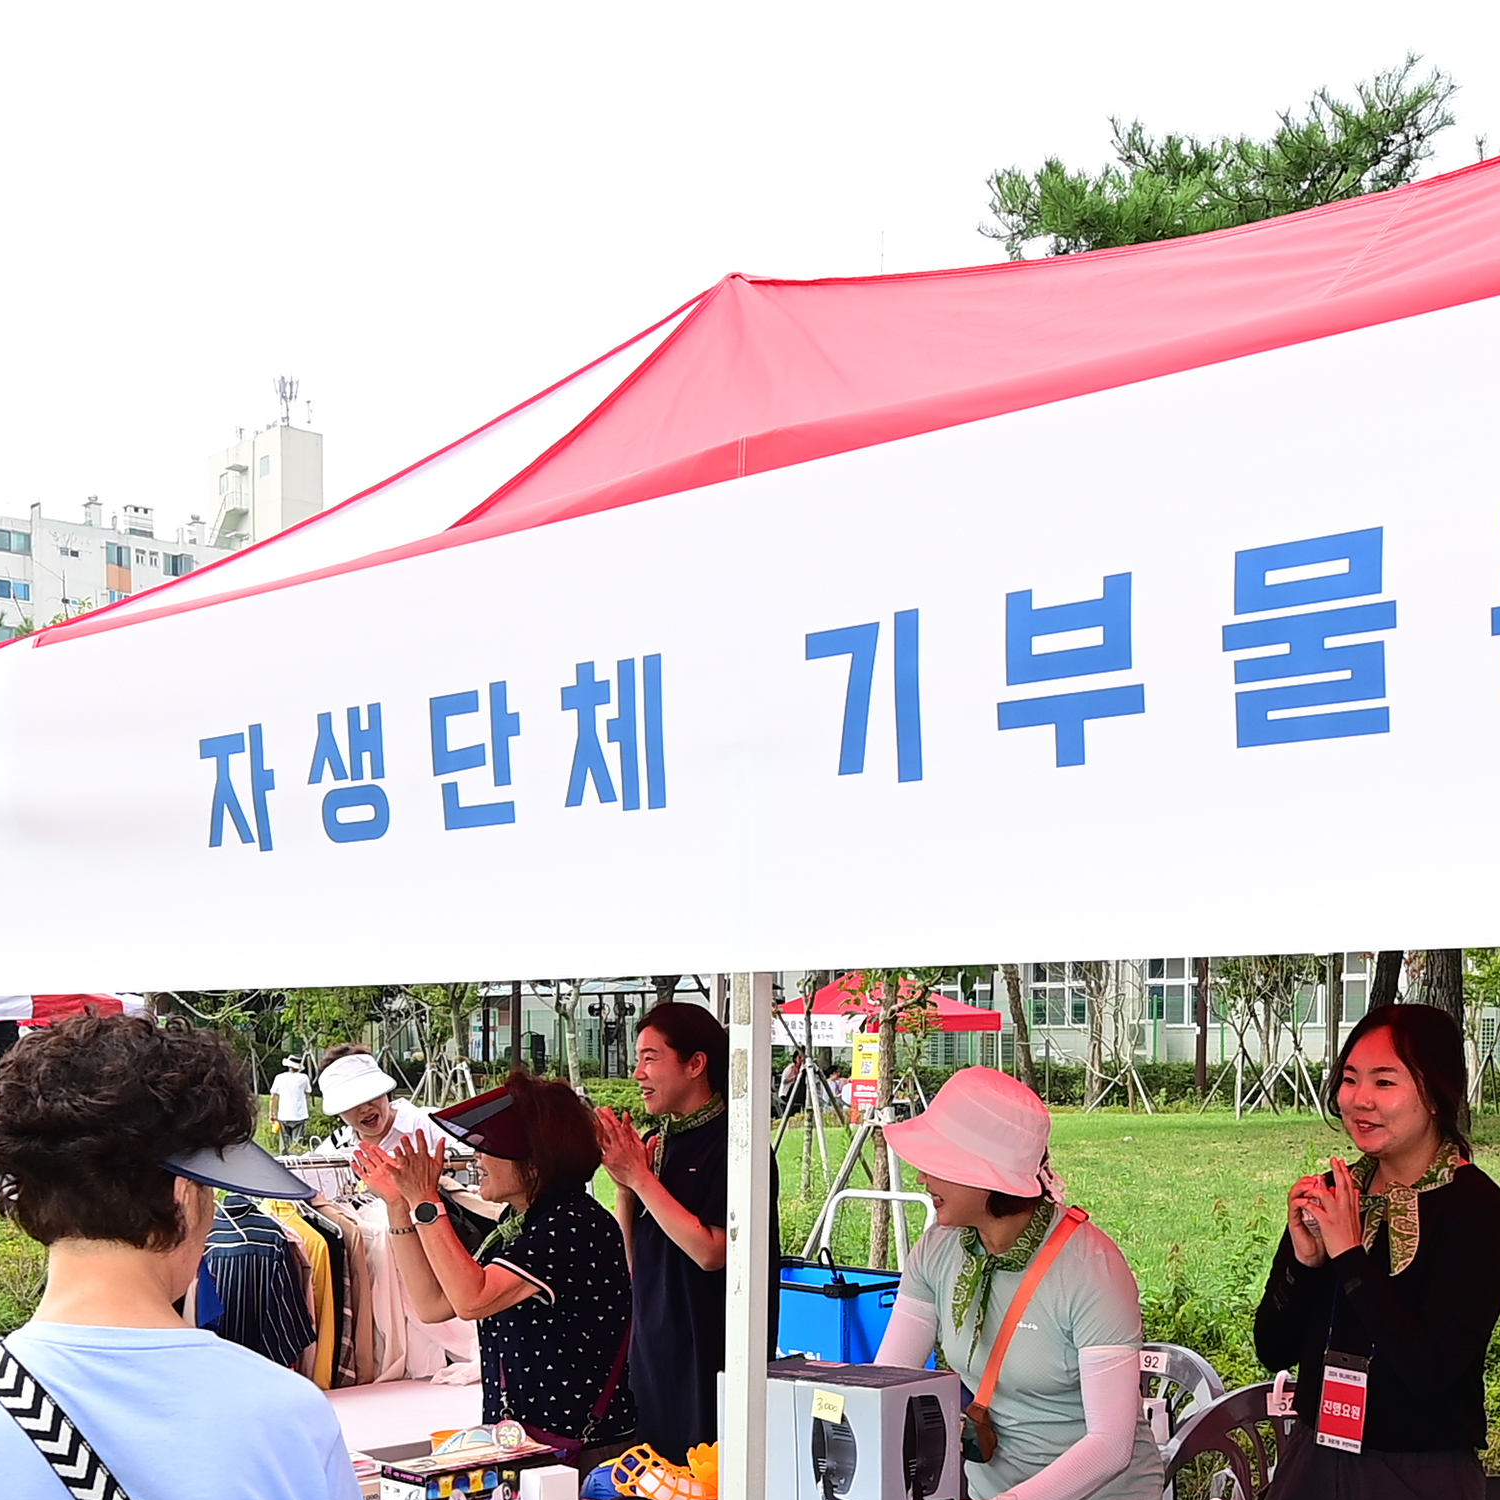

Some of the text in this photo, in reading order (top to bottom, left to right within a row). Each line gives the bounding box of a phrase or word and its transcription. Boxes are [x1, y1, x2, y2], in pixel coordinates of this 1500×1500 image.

[198, 652, 665, 852] 자생단체
[1144, 1355, 1160, 1368] 92
[1322, 1400, 1361, 1420] 진행요원
